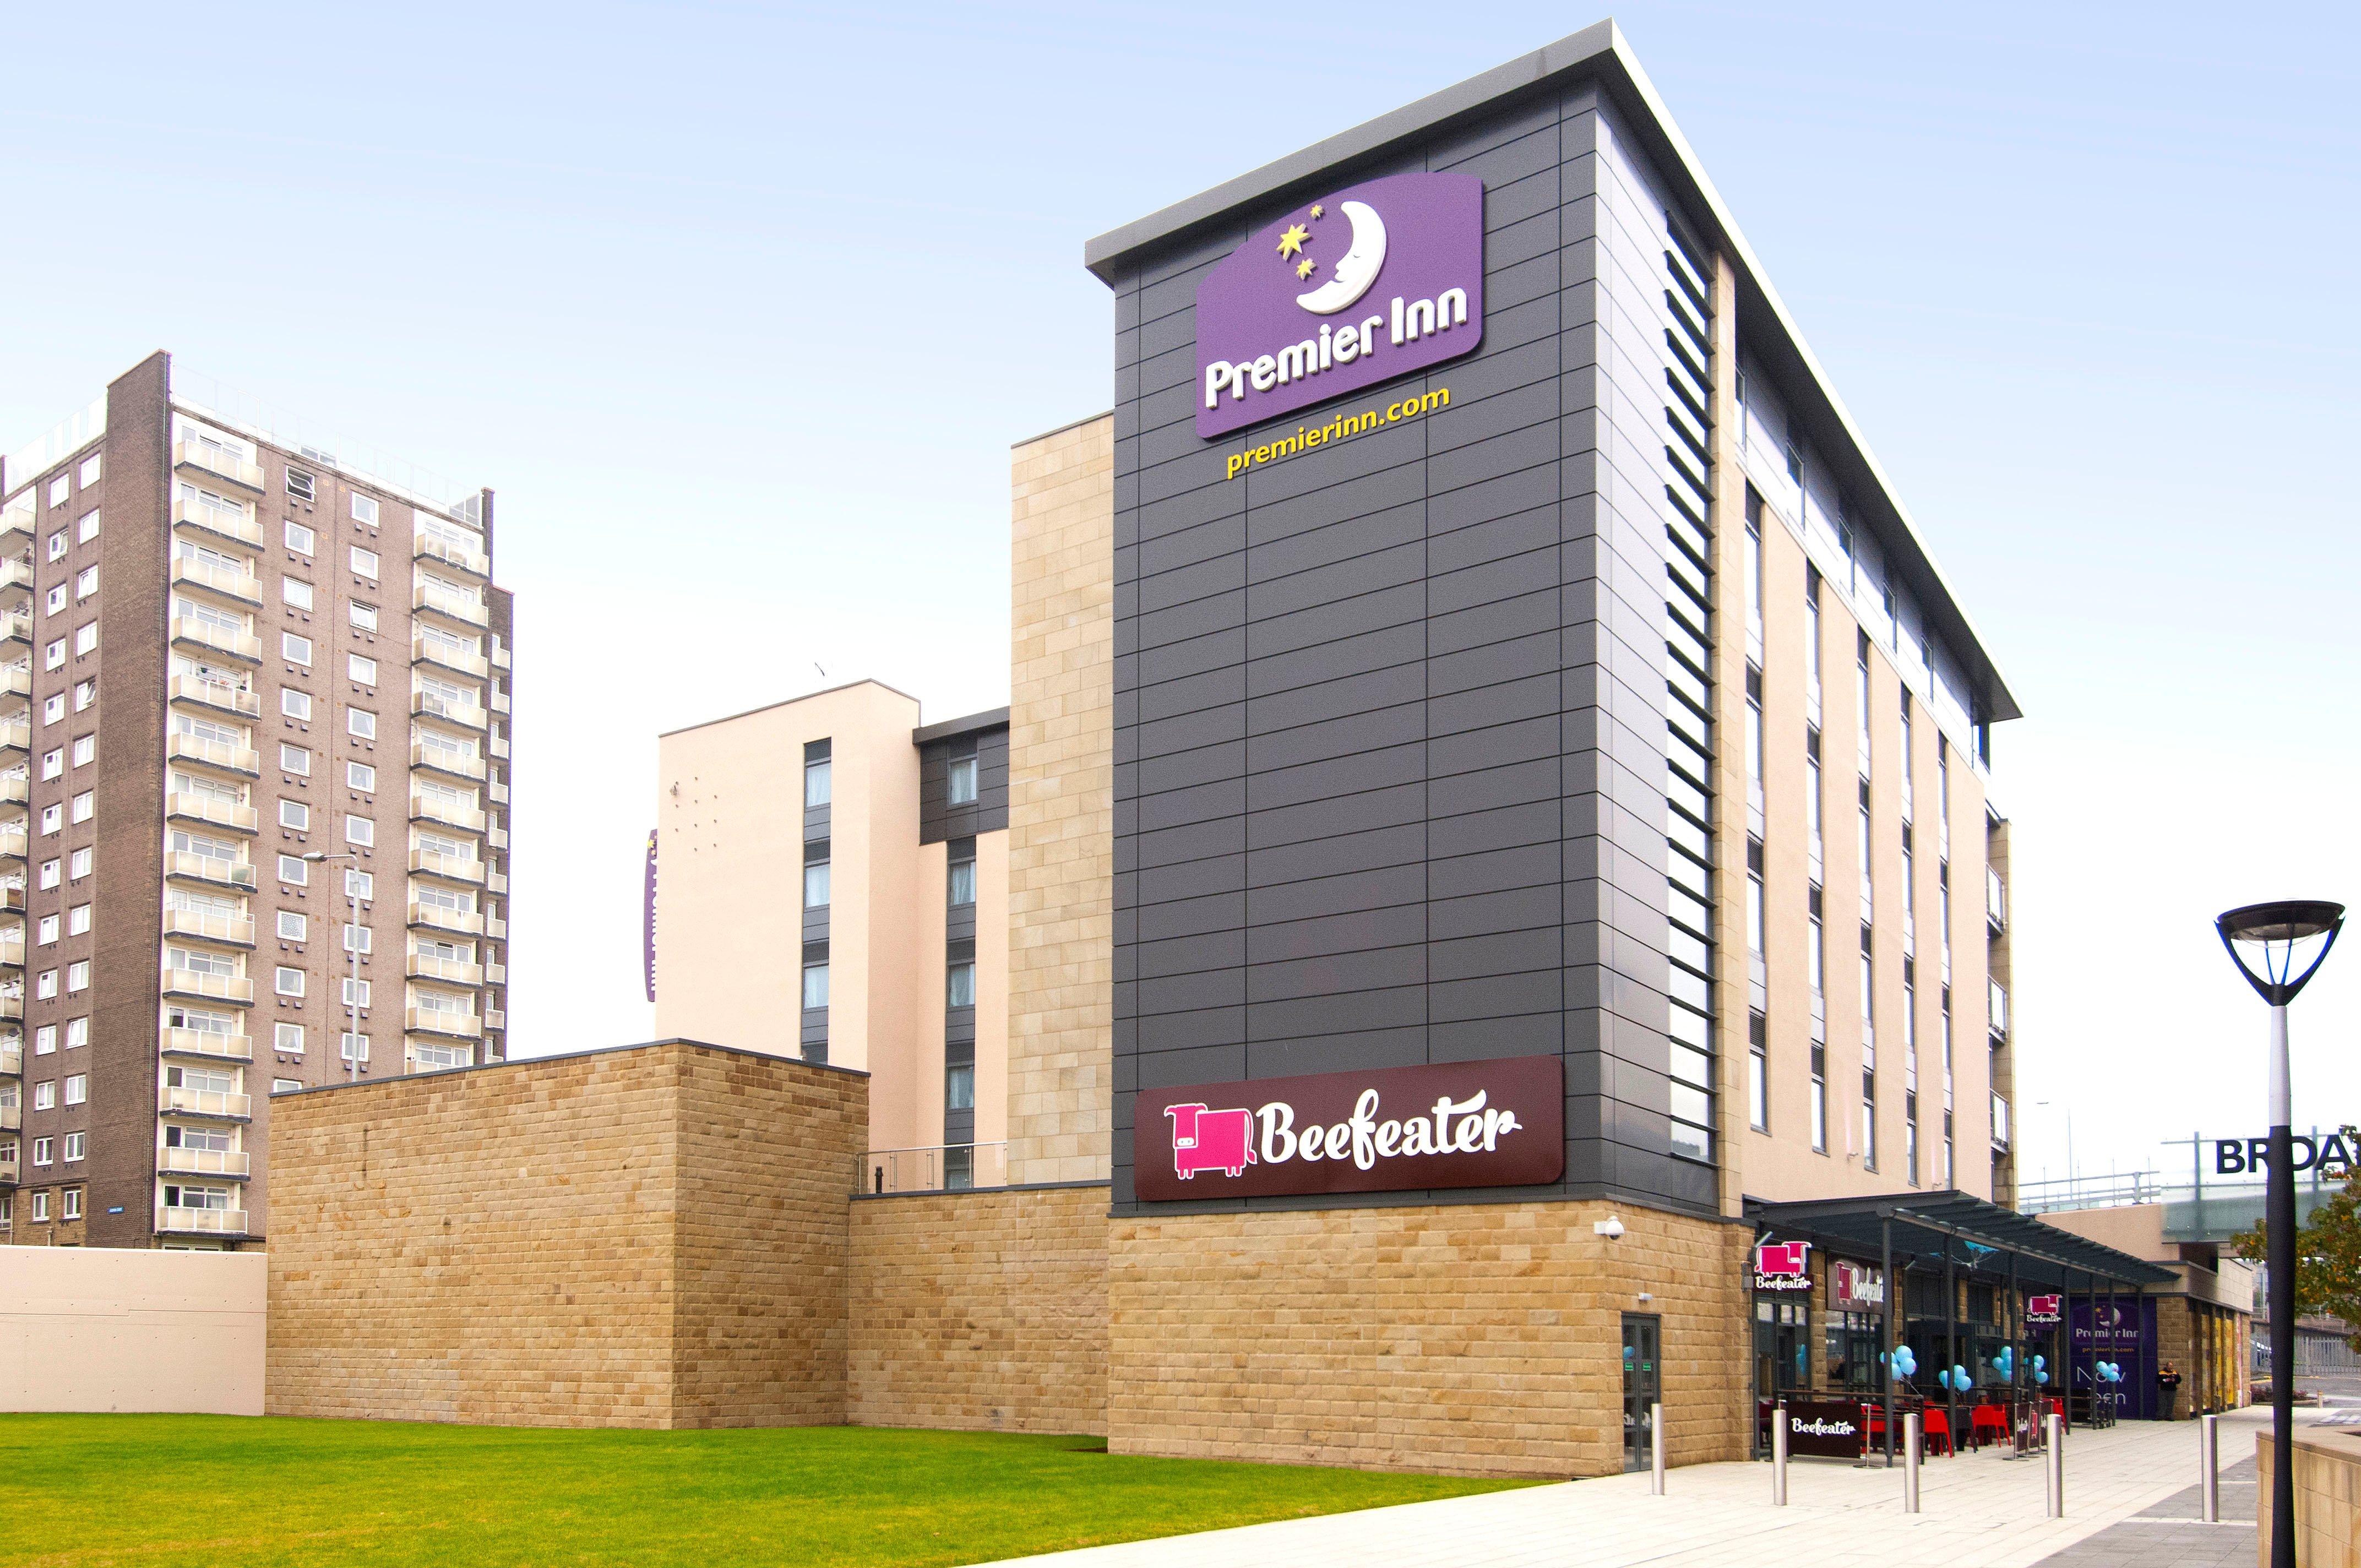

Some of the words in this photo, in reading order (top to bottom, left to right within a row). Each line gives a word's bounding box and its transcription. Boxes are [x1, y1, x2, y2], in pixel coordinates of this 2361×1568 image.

[1205, 315, 1383, 409] Premier
[1391, 287, 1467, 346] Inn
[1226, 387, 1451, 480] premierinn.com
[1255, 1088, 1523, 1171] Beefeater
[1755, 1275, 1812, 1291] Beefeater
[2026, 1314, 2061, 1323] Beefeater
[1791, 1417, 1856, 1436] Beefeater
